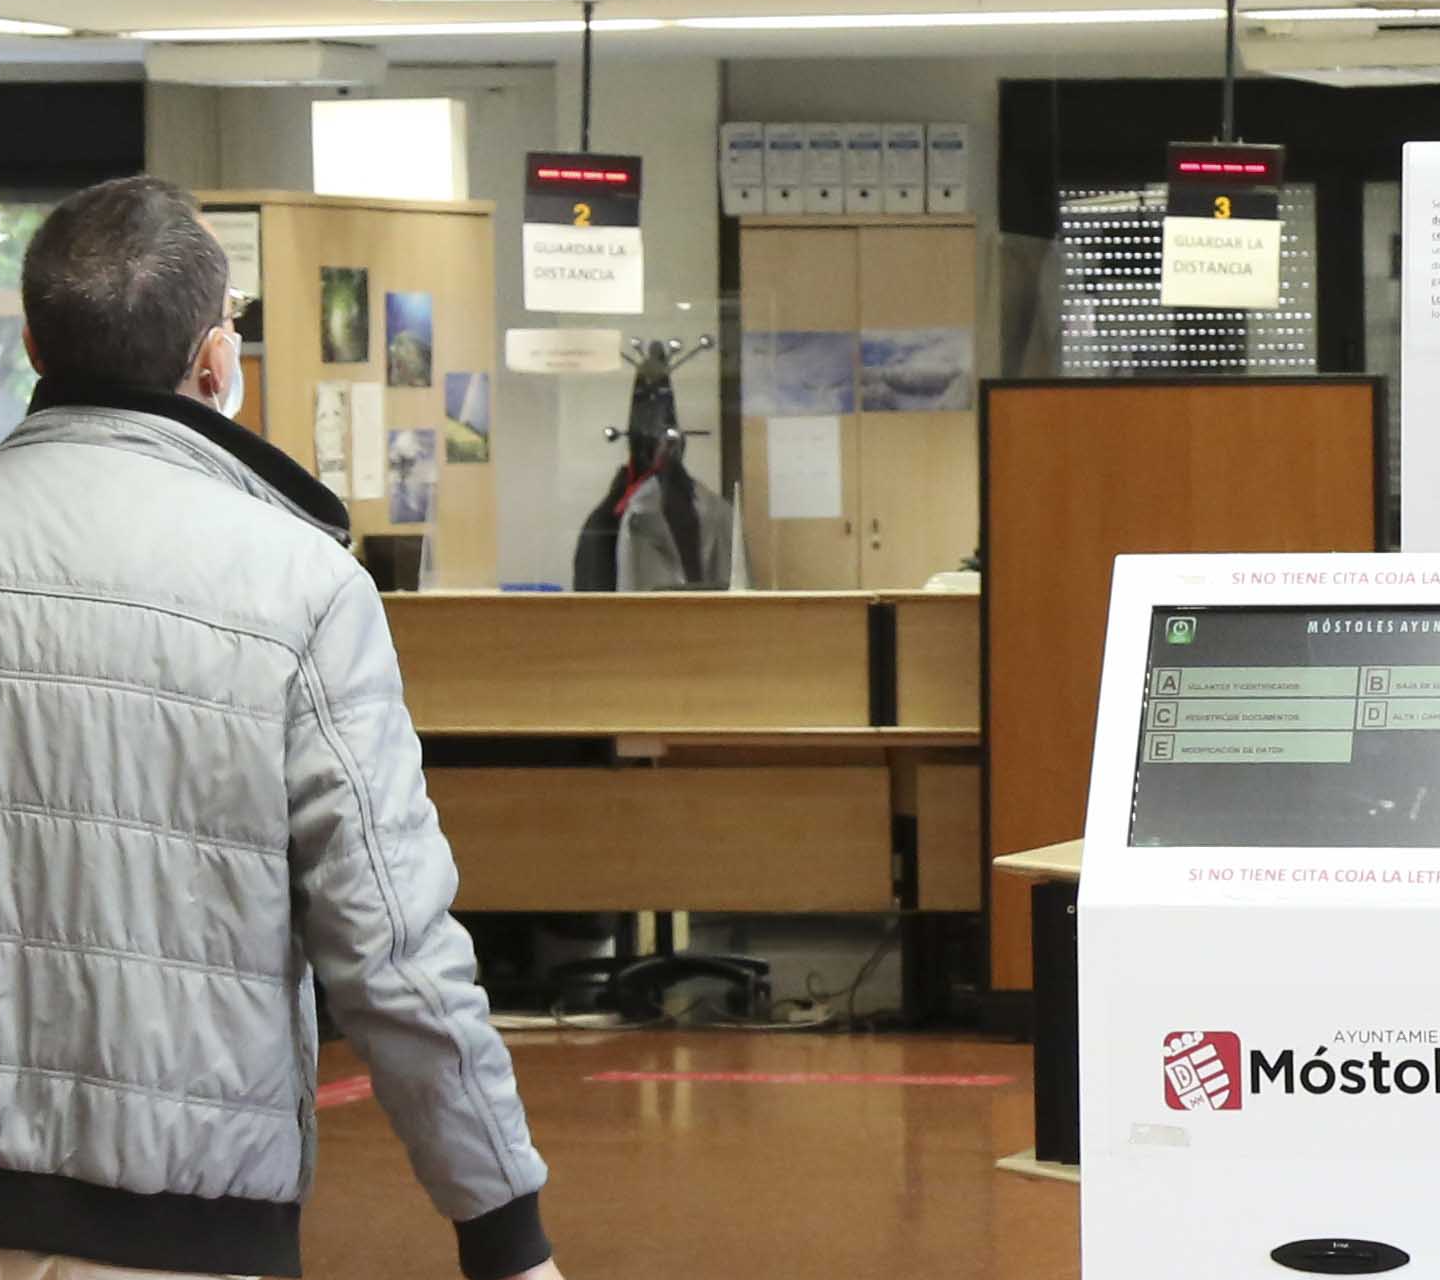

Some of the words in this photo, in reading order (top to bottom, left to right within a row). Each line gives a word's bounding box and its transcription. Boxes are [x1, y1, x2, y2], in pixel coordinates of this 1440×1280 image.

[572, 202, 592, 228] 2
[1214, 195, 1231, 220] 3
[1231, 571, 1245, 585] SI
[1250, 571, 1276, 585] NO
[1281, 571, 1328, 585] TIENE
[1332, 571, 1369, 585] CITA
[1374, 571, 1417, 585] COJA
[1307, 618, 1395, 634] MÓSTOLES
[1162, 675, 1177, 690] A
[1369, 676, 1384, 691] B
[1156, 708, 1171, 723] C
[1368, 707, 1380, 721] D
[1154, 741, 1168, 756] E
[1188, 868, 1203, 882] SI
[1208, 868, 1234, 882] NO
[1239, 868, 1287, 882] TIENE
[1291, 869, 1330, 883] CITA
[1334, 869, 1377, 883] COJA
[1381, 870, 1402, 884] LA
